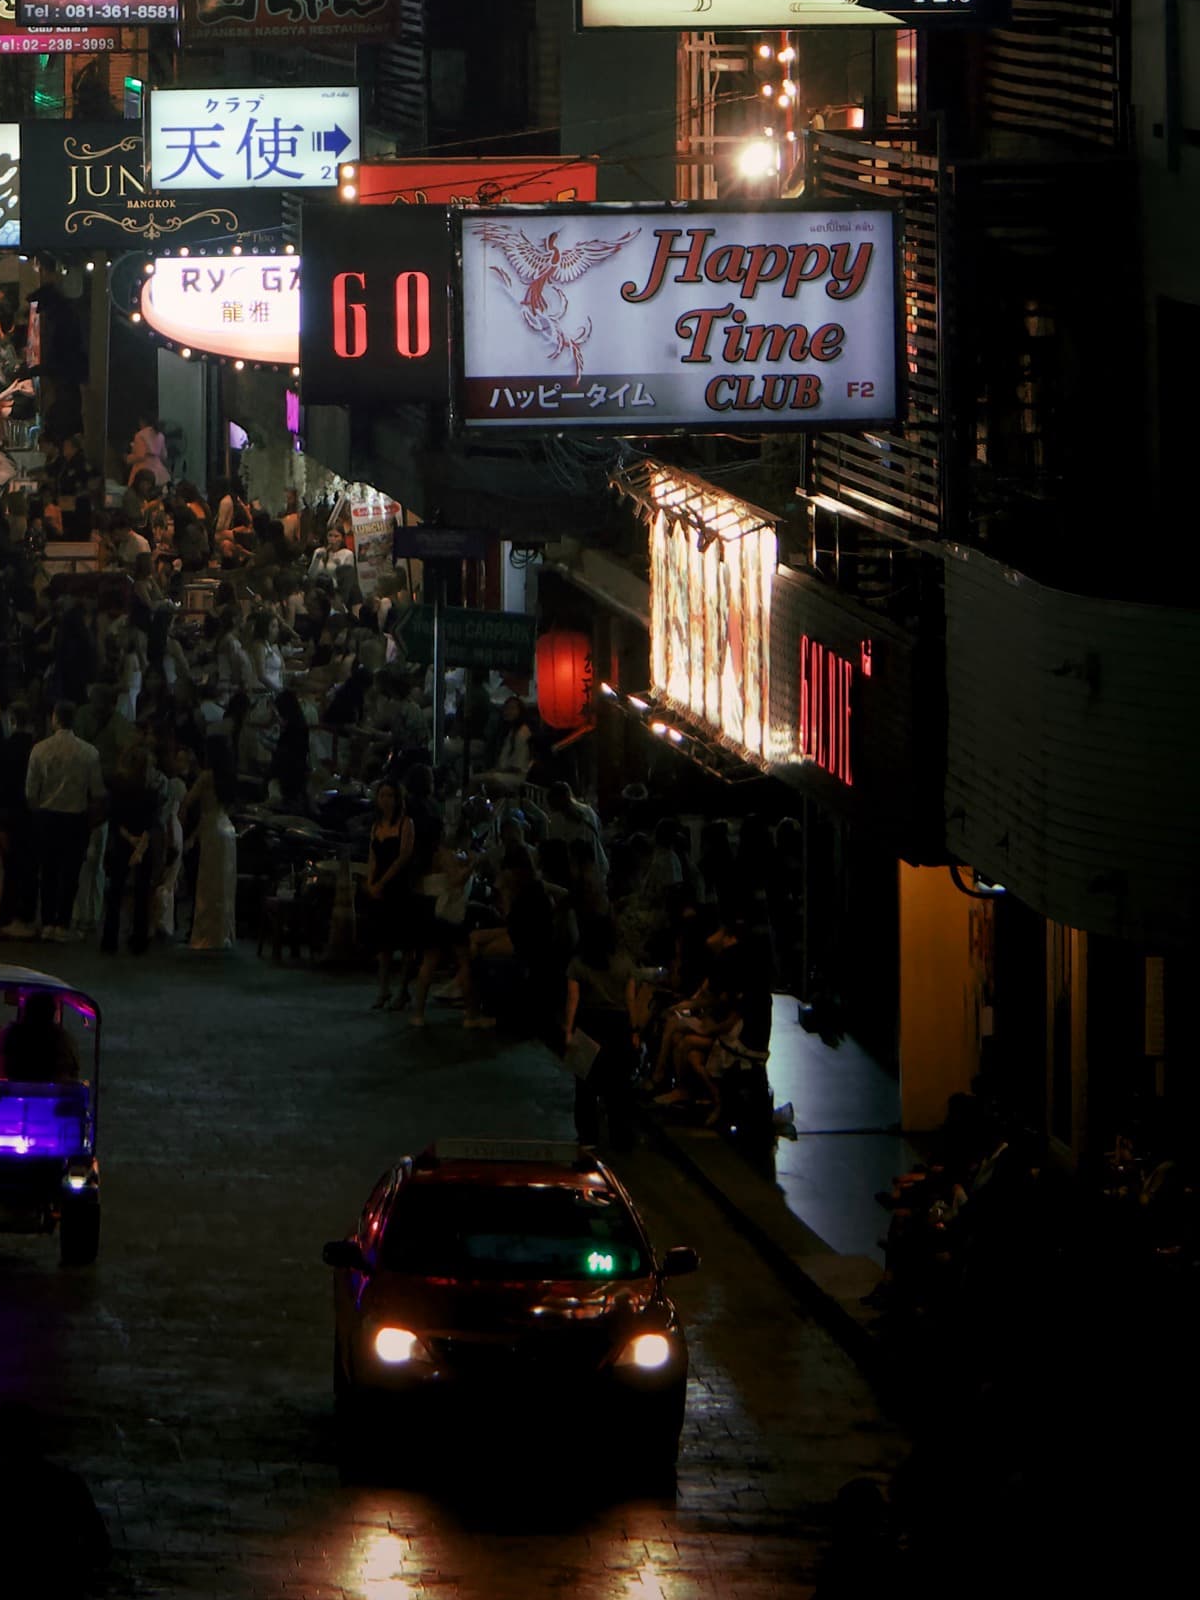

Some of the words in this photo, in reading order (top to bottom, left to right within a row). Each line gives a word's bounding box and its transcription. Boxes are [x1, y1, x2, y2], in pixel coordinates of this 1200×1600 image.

[24, 4, 49, 17] Tel
[66, 4, 176, 18] 081-361-8581
[205, 94, 265, 113] クラブ
[160, 117, 304, 182] 天使
[126, 199, 176, 209] BANGKOK
[620, 227, 875, 303] Happy
[675, 303, 845, 364] Time
[489, 381, 656, 409] ハッピータイム
[705, 374, 822, 411] CLUB
[847, 382, 875, 398] F2
